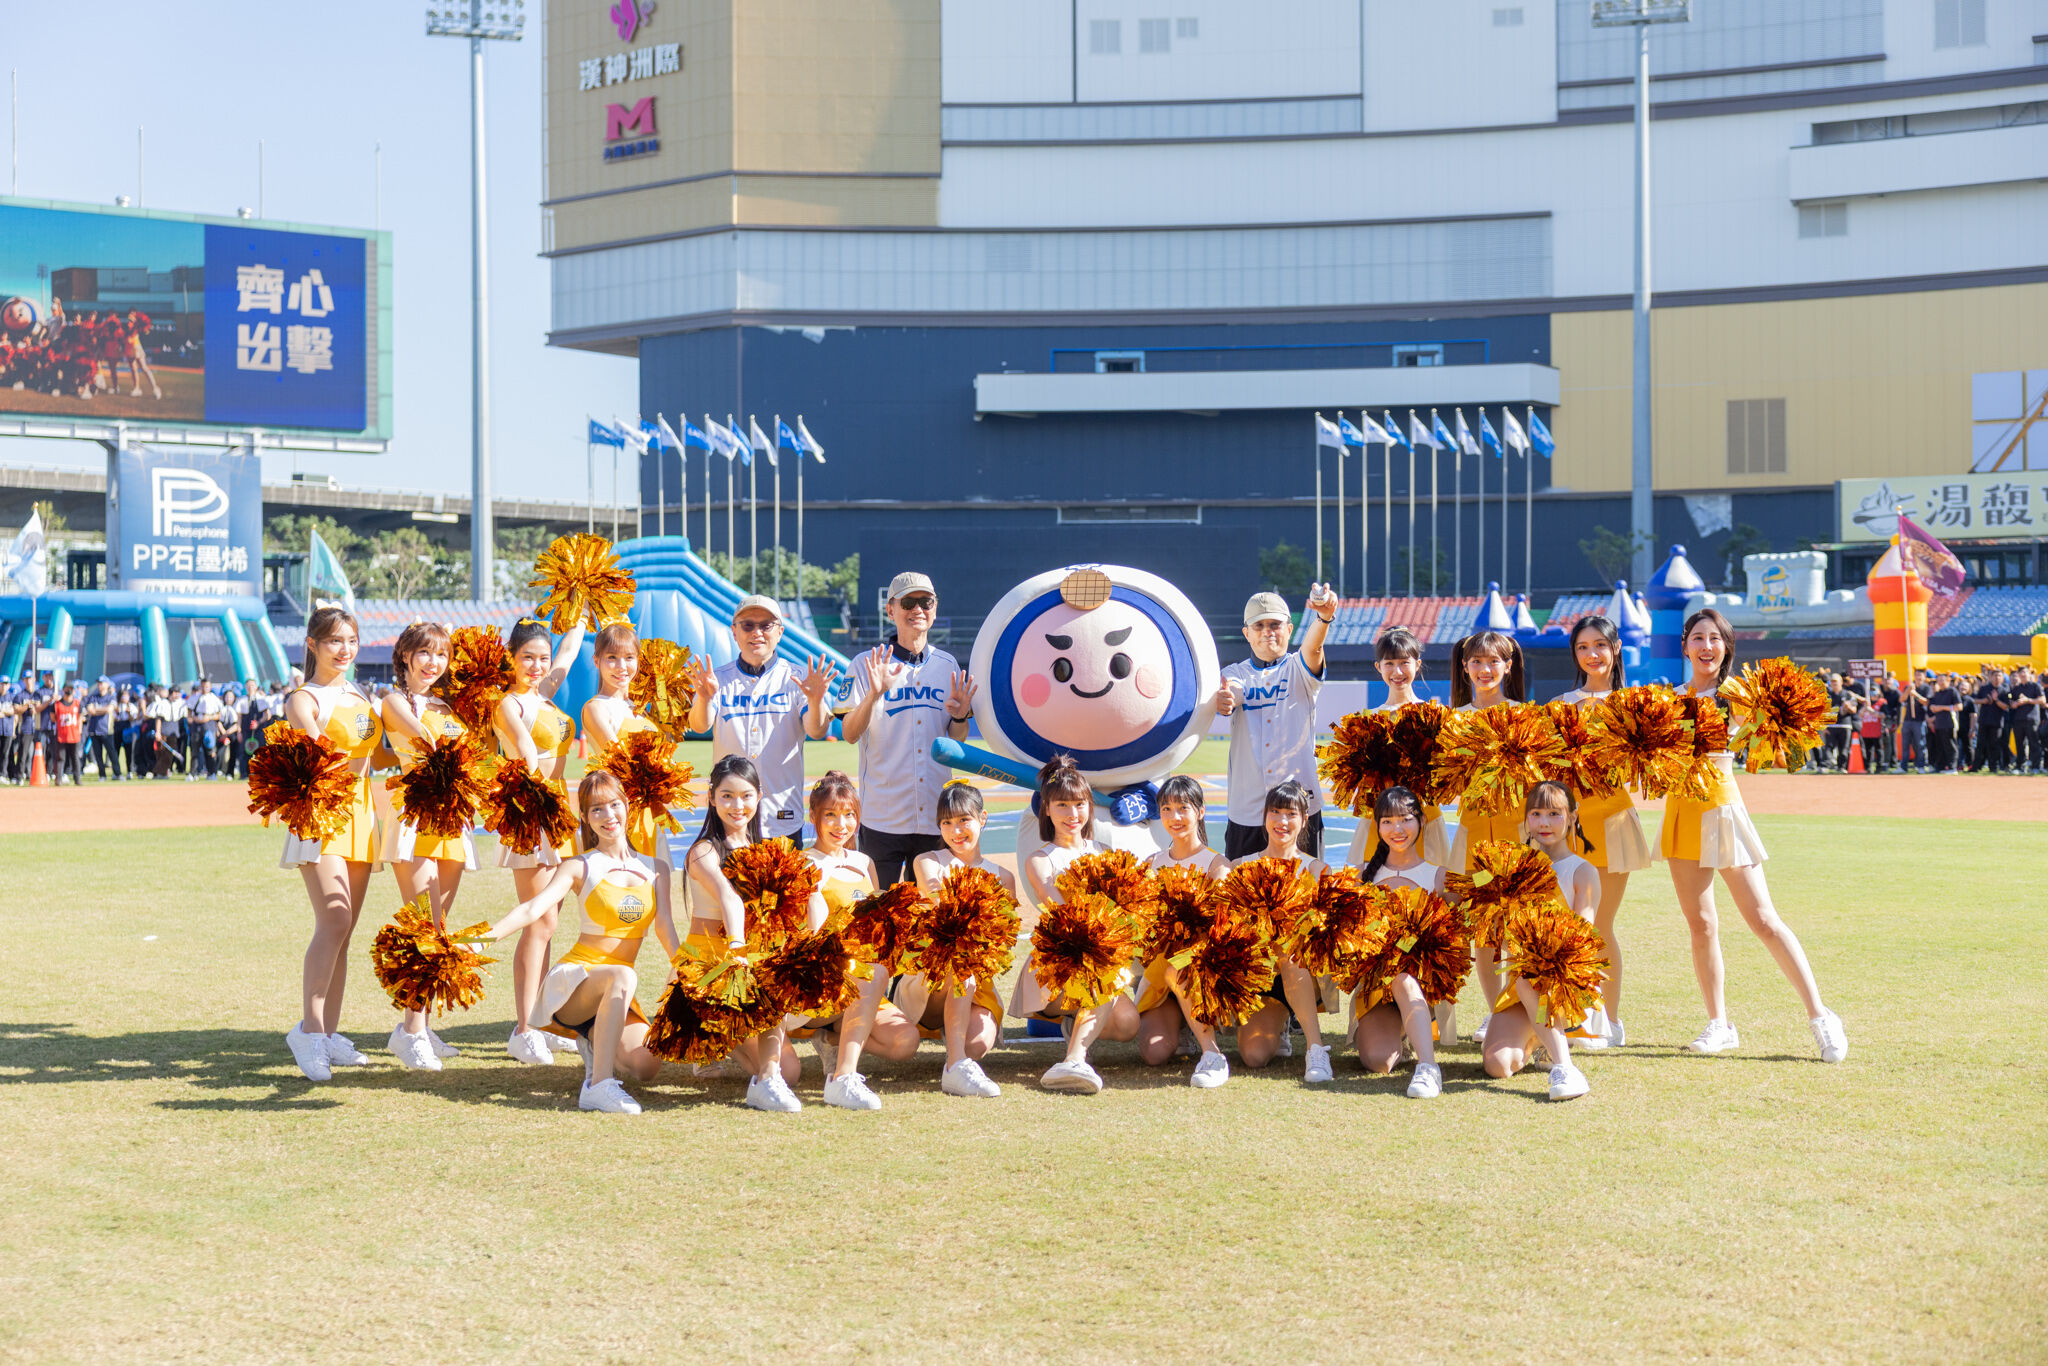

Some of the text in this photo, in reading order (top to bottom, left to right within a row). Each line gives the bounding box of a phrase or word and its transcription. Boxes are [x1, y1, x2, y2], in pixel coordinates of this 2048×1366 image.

[579, 43, 680, 91] 漢神洲際
[236, 264, 335, 317] 齊心
[236, 322, 334, 374] 出擊
[1925, 483, 2048, 528] 湯馥
[173, 525, 229, 540] Persephone
[133, 543, 248, 574] PP石墨烯
[721, 692, 789, 708] UMC
[884, 686, 945, 702] UMC
